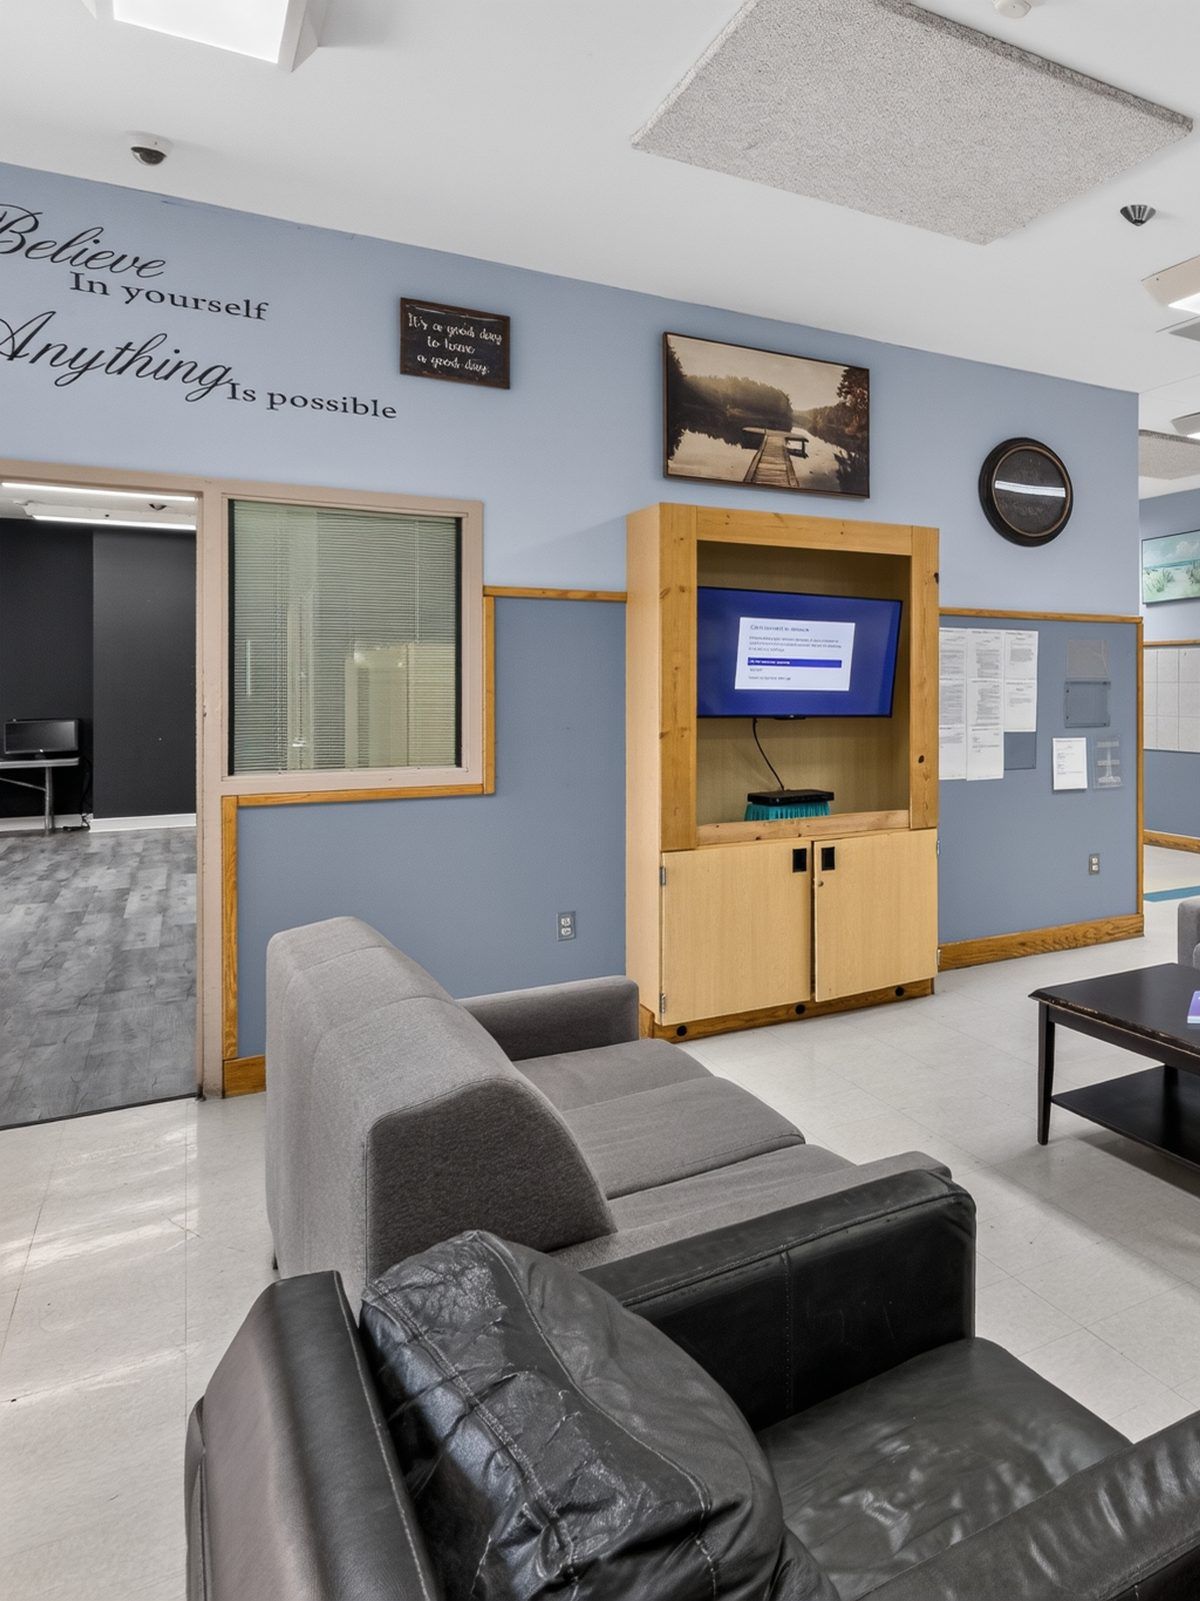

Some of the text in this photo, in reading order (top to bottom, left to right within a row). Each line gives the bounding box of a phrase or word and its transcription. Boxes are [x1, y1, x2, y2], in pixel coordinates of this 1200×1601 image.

[0, 204, 166, 278] Believe
[69, 271, 269, 321] In yourself
[408, 312, 502, 345] It's a good day
[427, 335, 476, 354] to have
[0, 311, 398, 420] Anything Is possible
[417, 354, 427, 364] a
[431, 356, 460, 369] good
